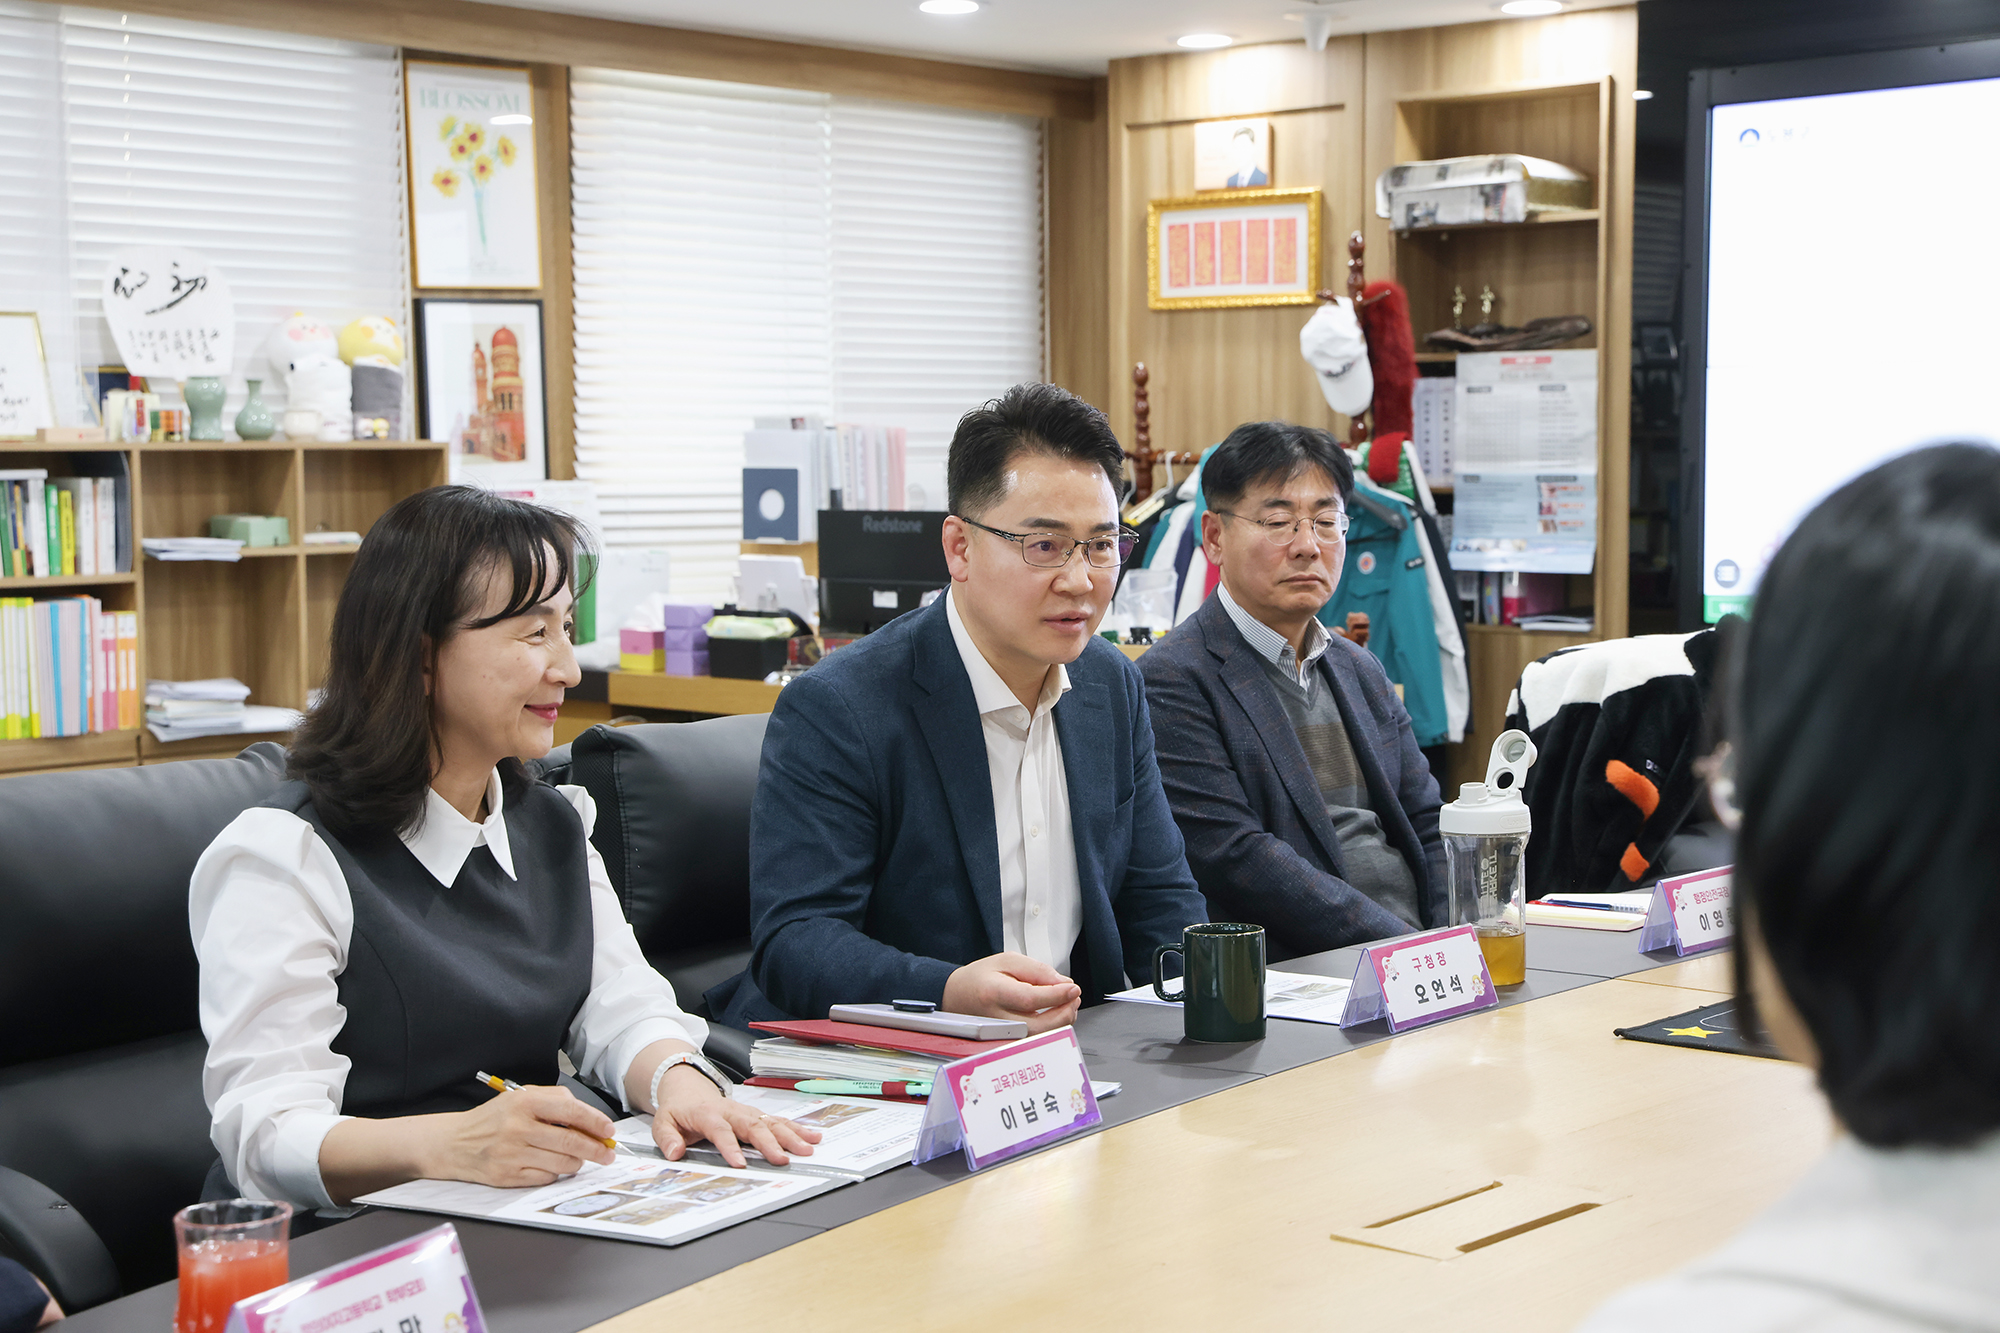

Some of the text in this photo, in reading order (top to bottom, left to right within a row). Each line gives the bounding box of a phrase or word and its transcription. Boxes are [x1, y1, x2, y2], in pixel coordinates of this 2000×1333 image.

[419, 86, 519, 113] BLOSSOM
[862, 515, 922, 533] Redstone
[1412, 951, 1447, 973] 구청장
[1415, 974, 1464, 1004] 오언석
[991, 1063, 1046, 1094] 교육지원과장
[1000, 1091, 1060, 1130] 이남숙
